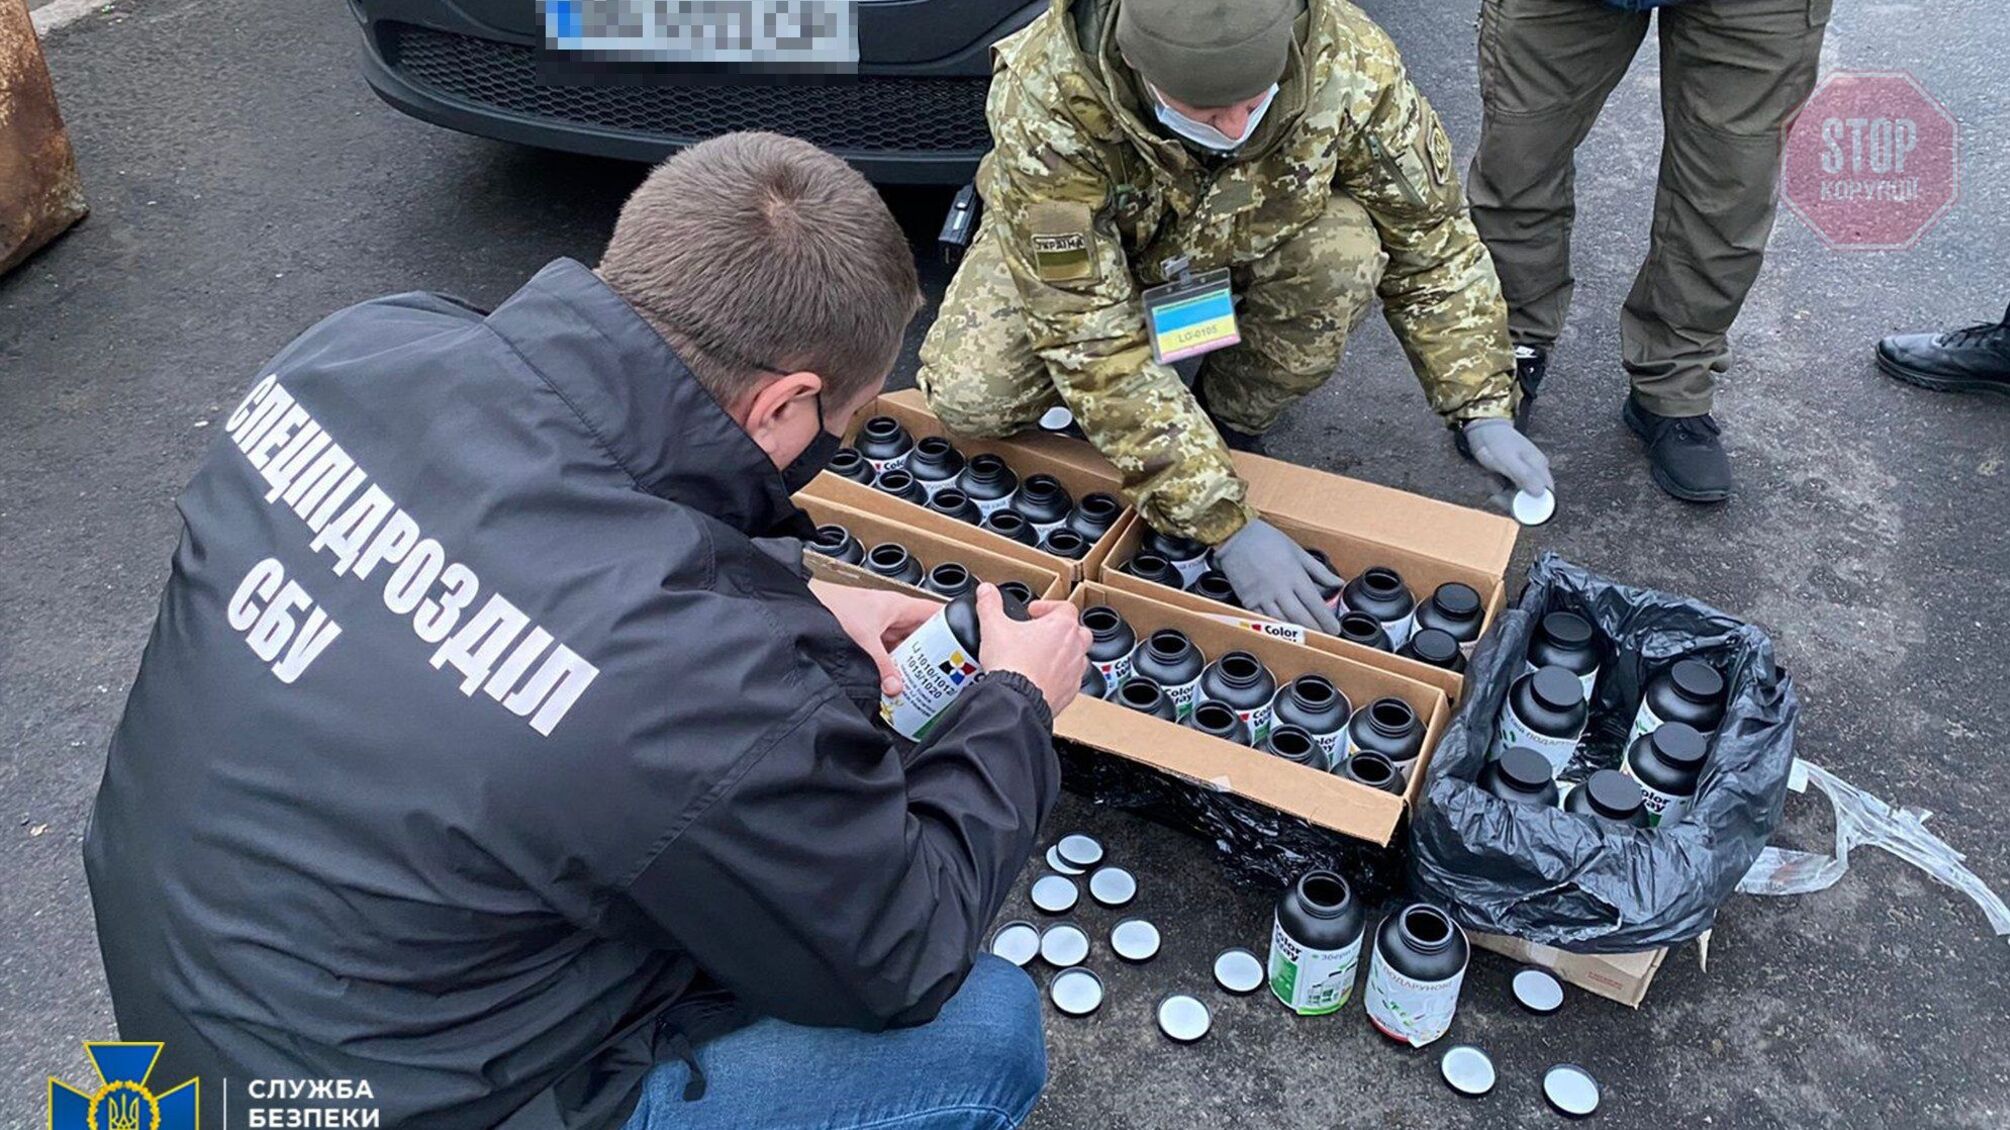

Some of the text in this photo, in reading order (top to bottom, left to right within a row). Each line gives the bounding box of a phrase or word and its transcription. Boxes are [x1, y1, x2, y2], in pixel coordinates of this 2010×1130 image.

[225, 373, 600, 737] СПЕЦПІДРОЗДІЛ
[227, 557, 343, 684] СБУ
[1265, 625, 1298, 638] Color
[907, 655, 942, 699] 1015/1020
[1641, 789, 1671, 804] olor
[1645, 800, 1665, 813] ay
